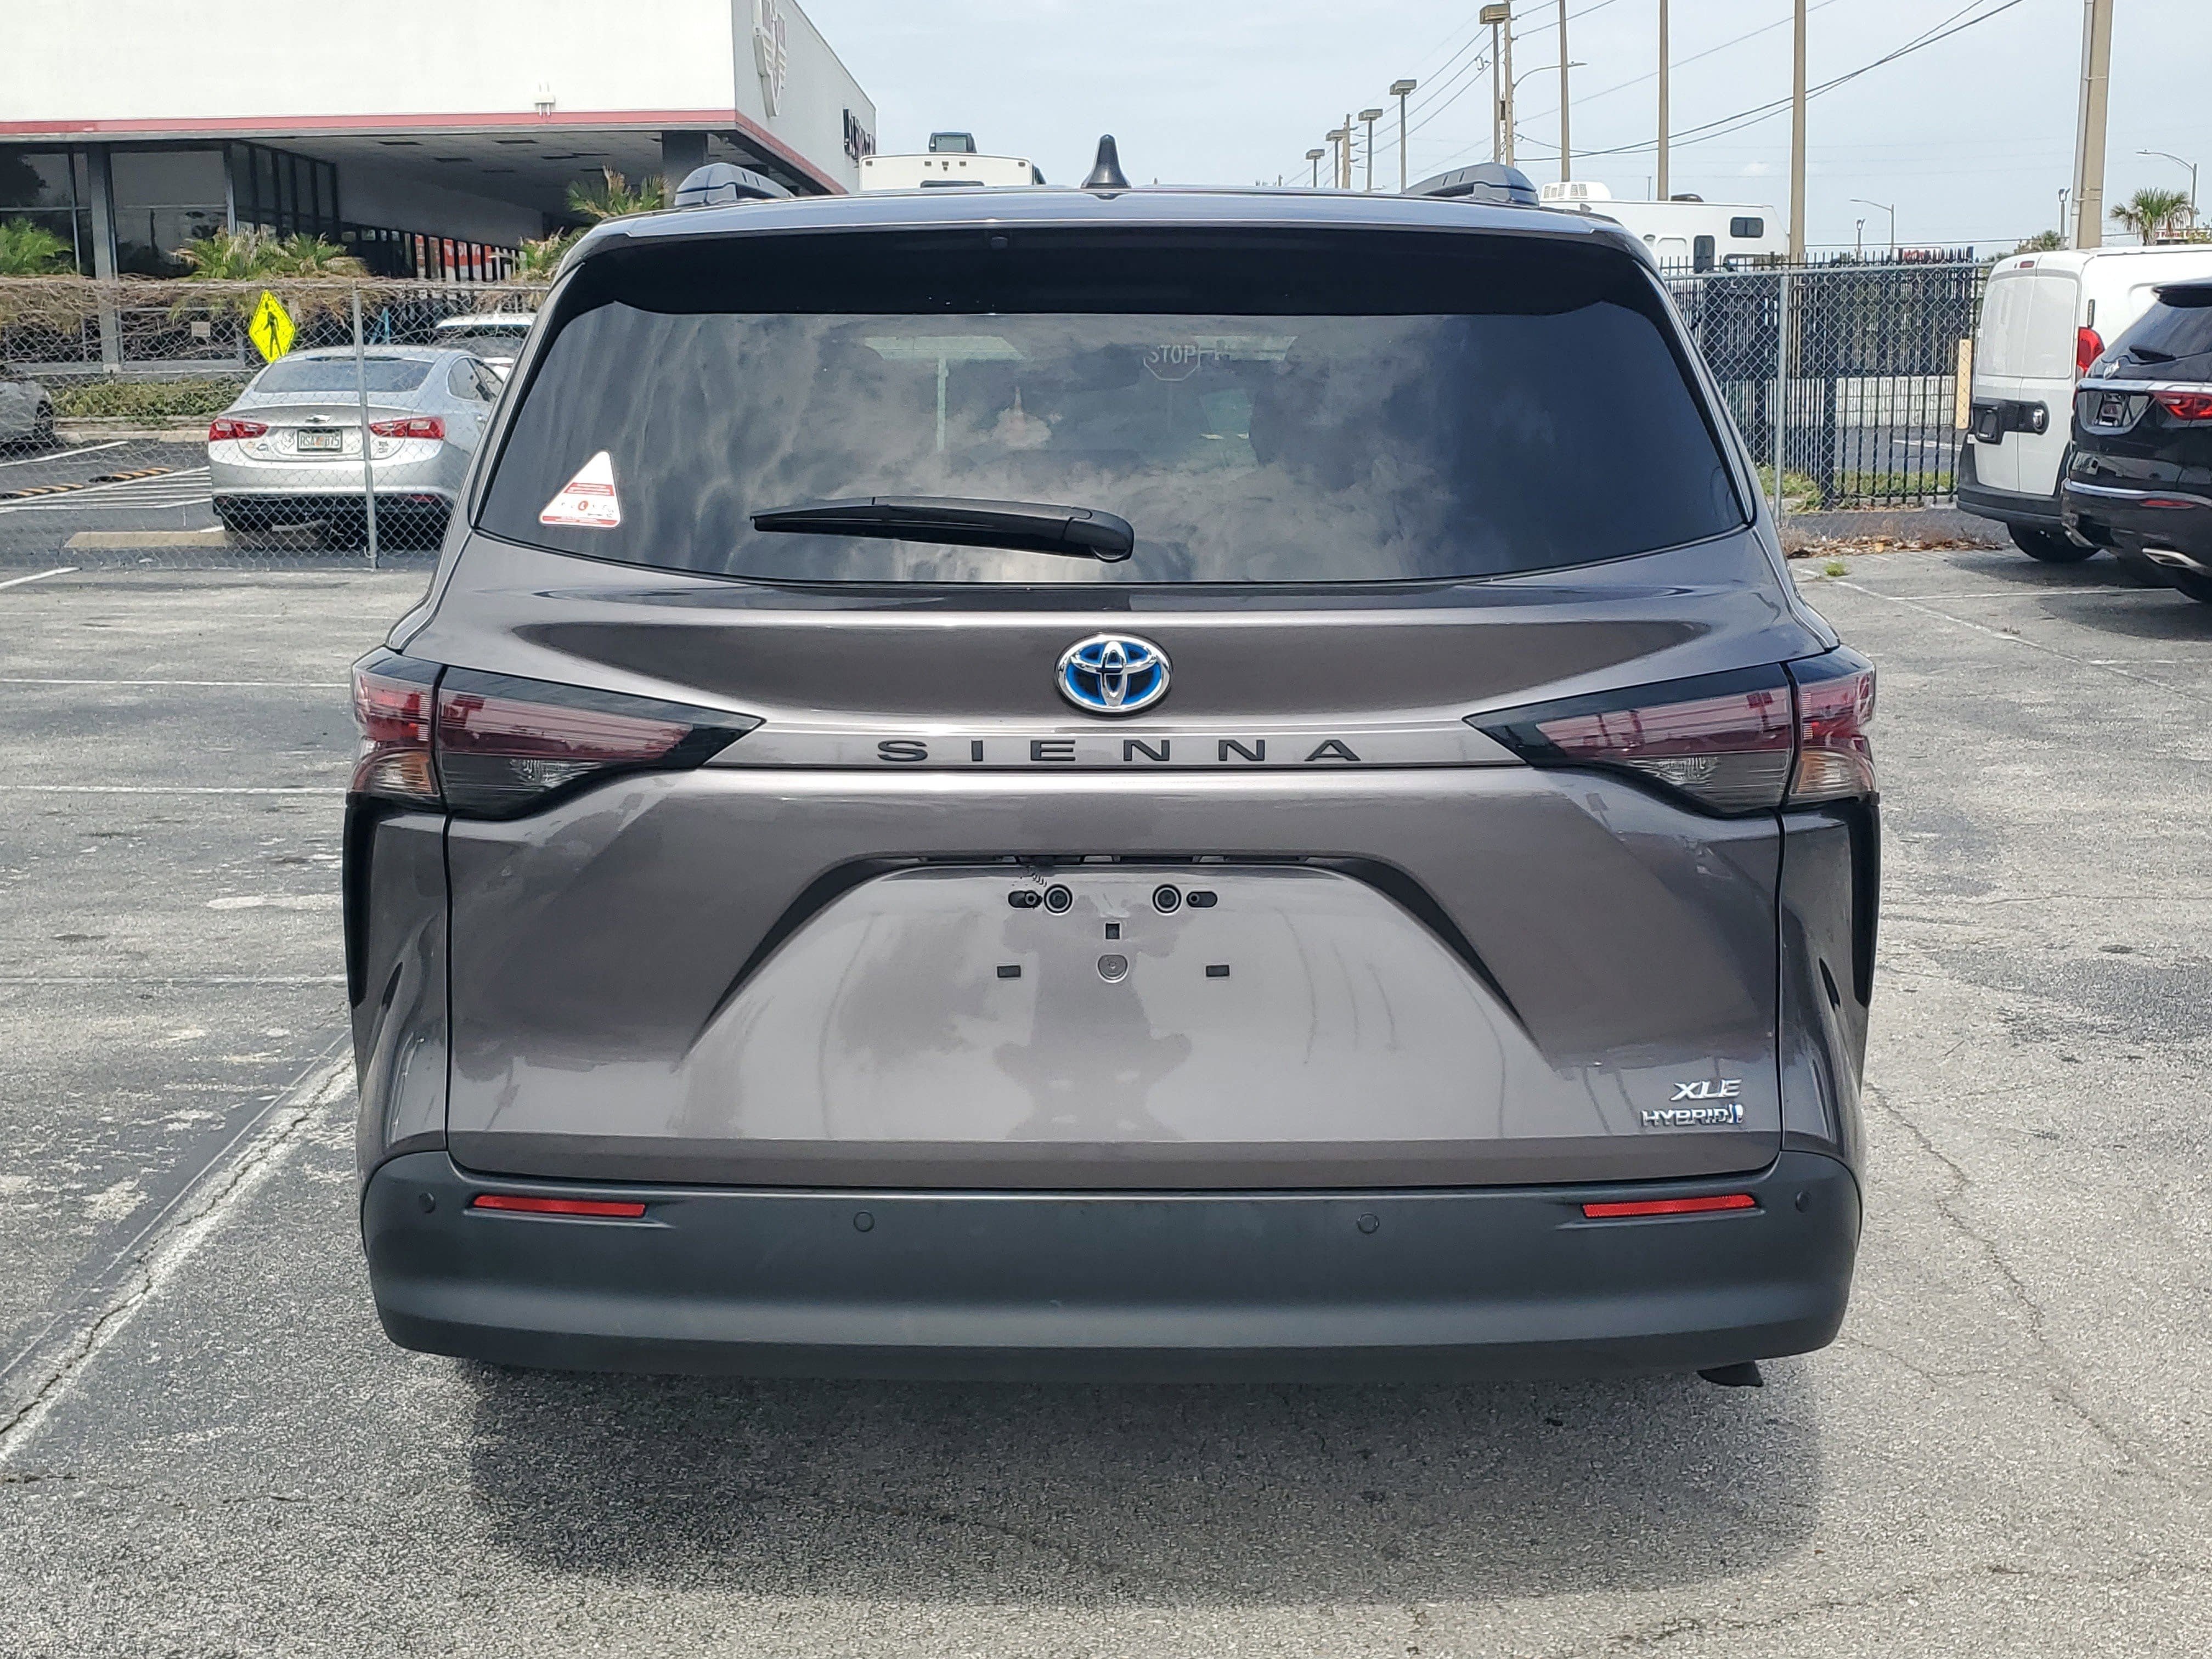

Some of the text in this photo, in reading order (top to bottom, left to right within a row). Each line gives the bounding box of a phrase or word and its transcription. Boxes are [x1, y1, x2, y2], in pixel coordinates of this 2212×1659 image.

[878, 740, 1361, 761] SIENNA
[1671, 1080, 1742, 1101] XLE
[1641, 1108, 1729, 1126] HYBRID
